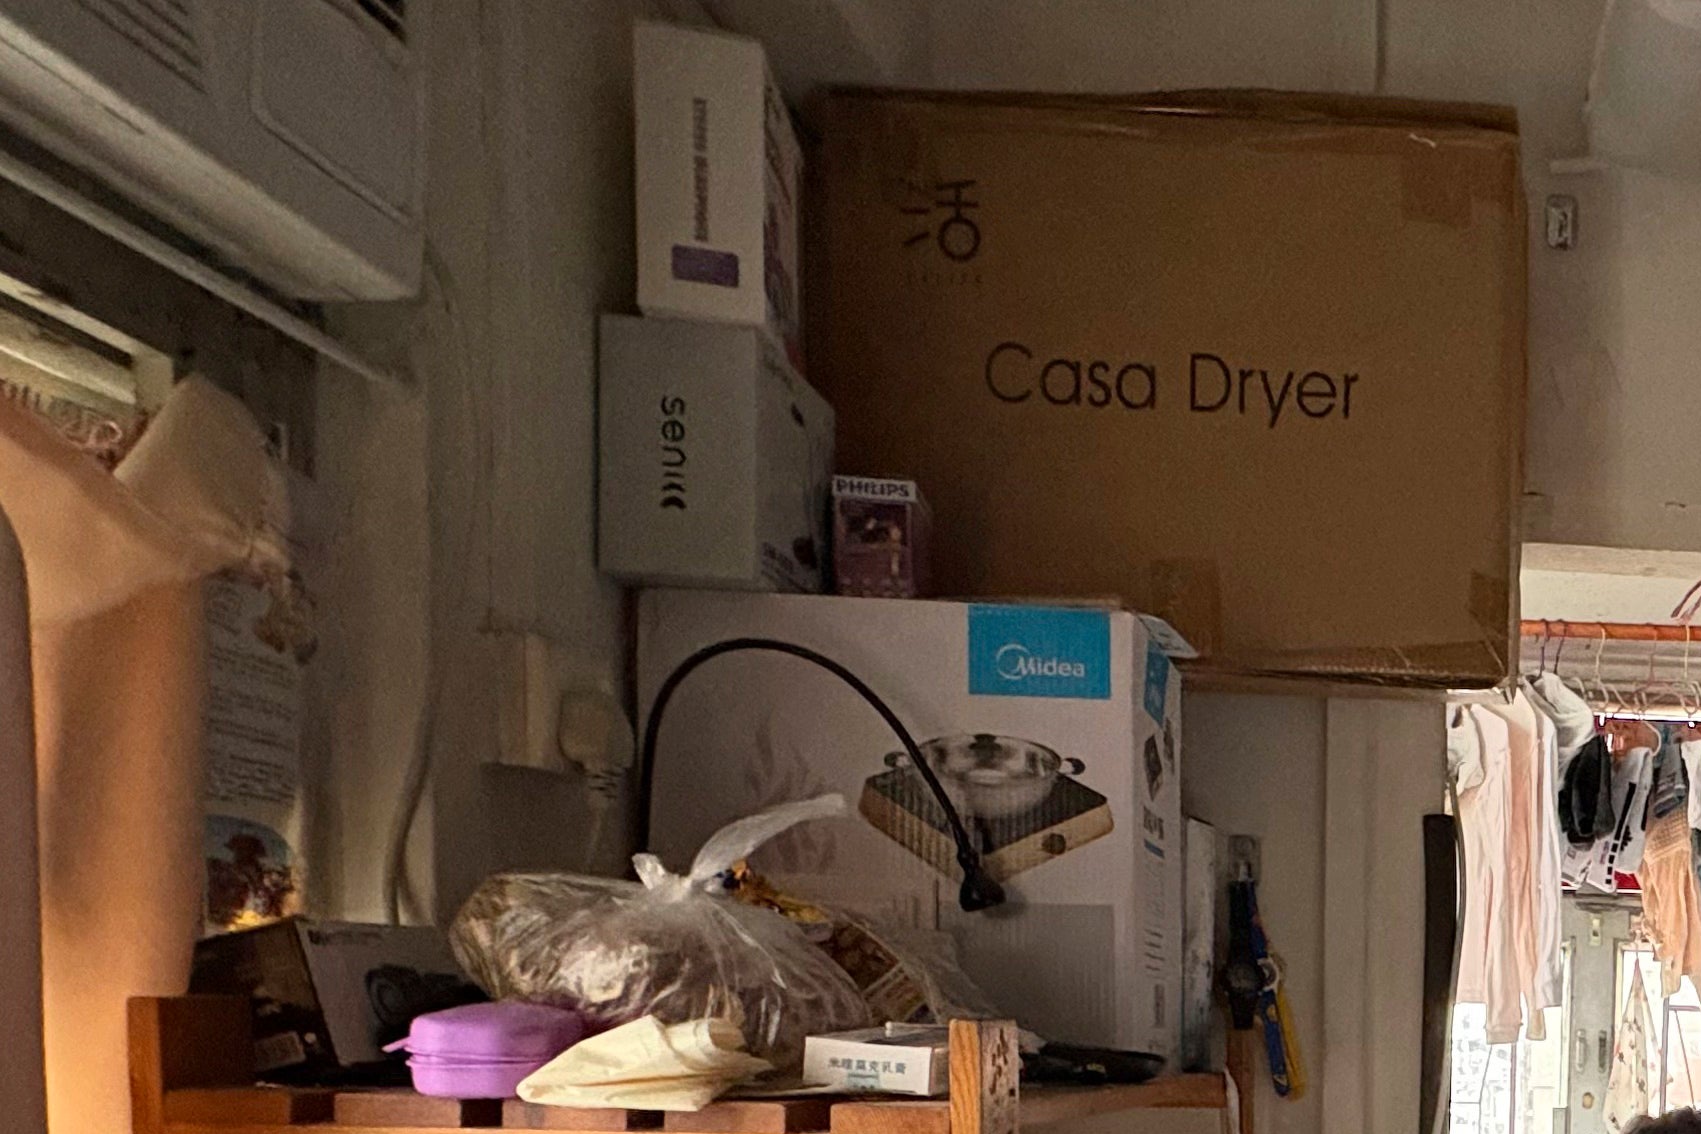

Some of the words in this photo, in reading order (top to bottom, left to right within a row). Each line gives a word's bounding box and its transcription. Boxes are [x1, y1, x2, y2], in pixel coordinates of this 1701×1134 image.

[985, 341, 1157, 410] Casa
[1189, 352, 1359, 429] Dryer
[835, 478, 910, 498] PHILIPS
[1010, 654, 1086, 678] Midea
